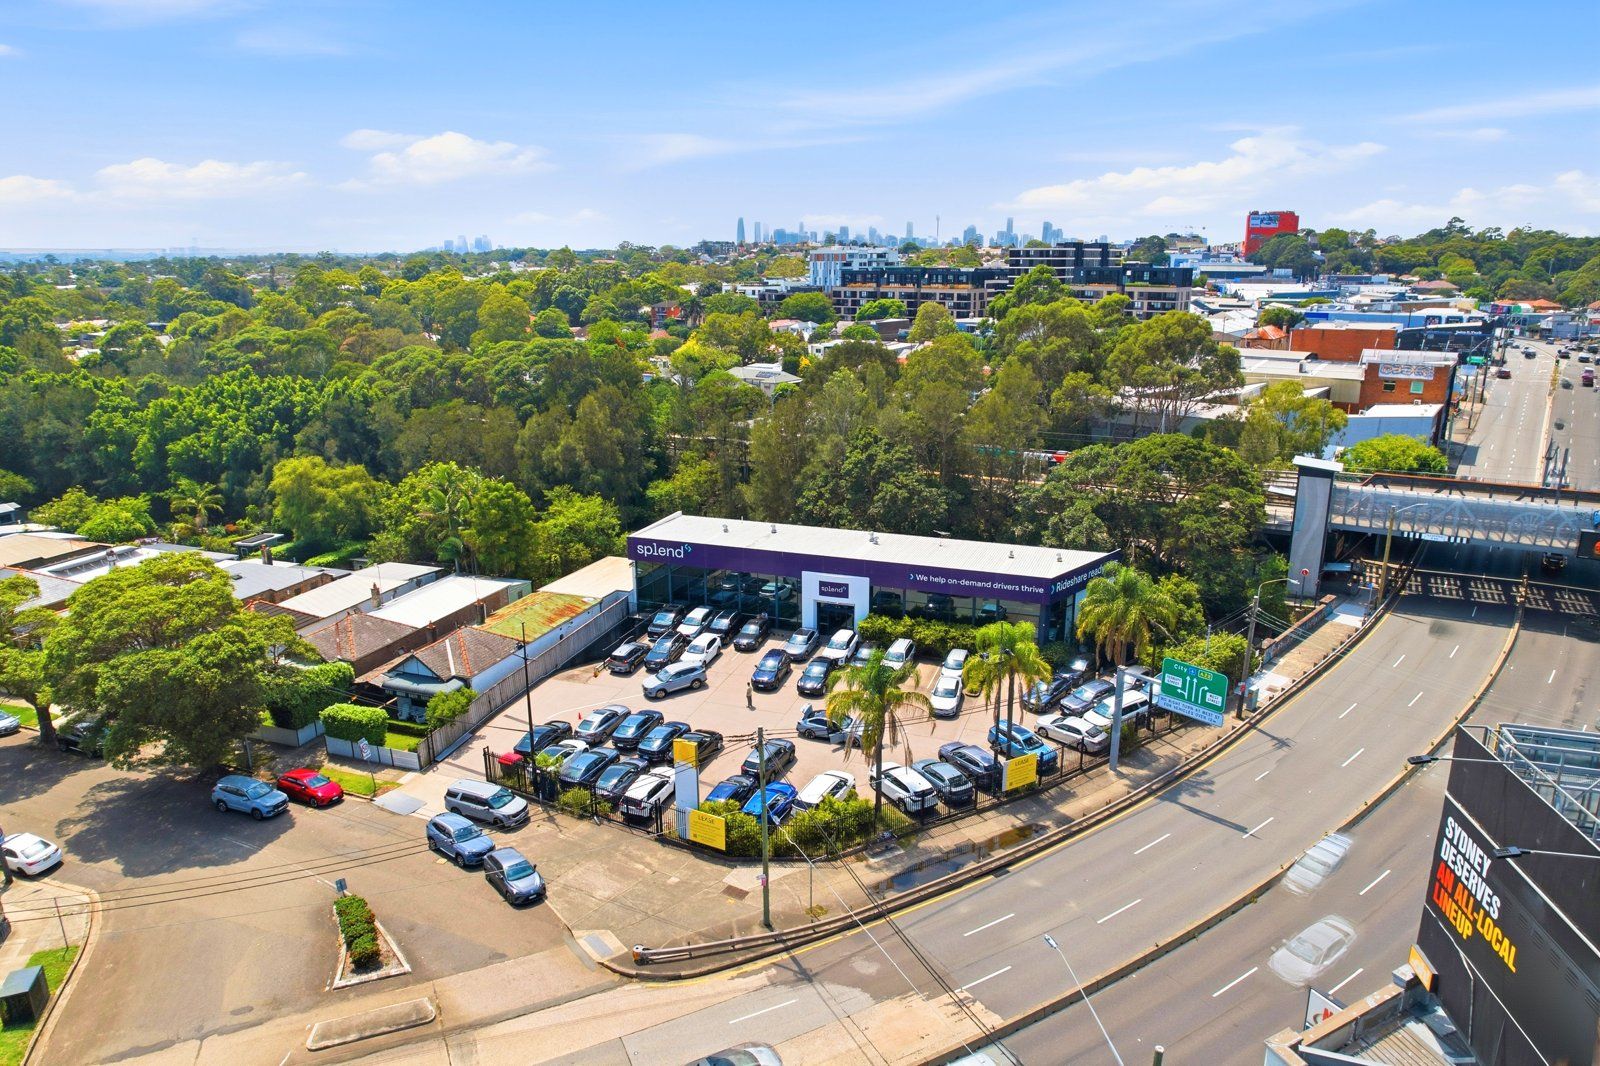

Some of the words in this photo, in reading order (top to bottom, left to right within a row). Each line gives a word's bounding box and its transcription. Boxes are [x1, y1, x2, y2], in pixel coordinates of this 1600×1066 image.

[637, 542, 684, 558] splend
[821, 585, 843, 593] splend
[929, 576, 946, 584] help
[947, 578, 991, 588] on-demand
[993, 582, 1019, 591] drivers
[1021, 585, 1044, 594] thrive
[1056, 573, 1088, 593] Rideshare
[1174, 664, 1187, 673] City
[1014, 758, 1029, 767] LEASE
[697, 815, 714, 824] LEASE
[1445, 816, 1492, 879] SYDNEY
[1440, 837, 1501, 920] DESERVES
[1432, 882, 1473, 940] LINEUP
[1436, 861, 1455, 894] AN
[1453, 882, 1518, 974] ALL-LOCAL
